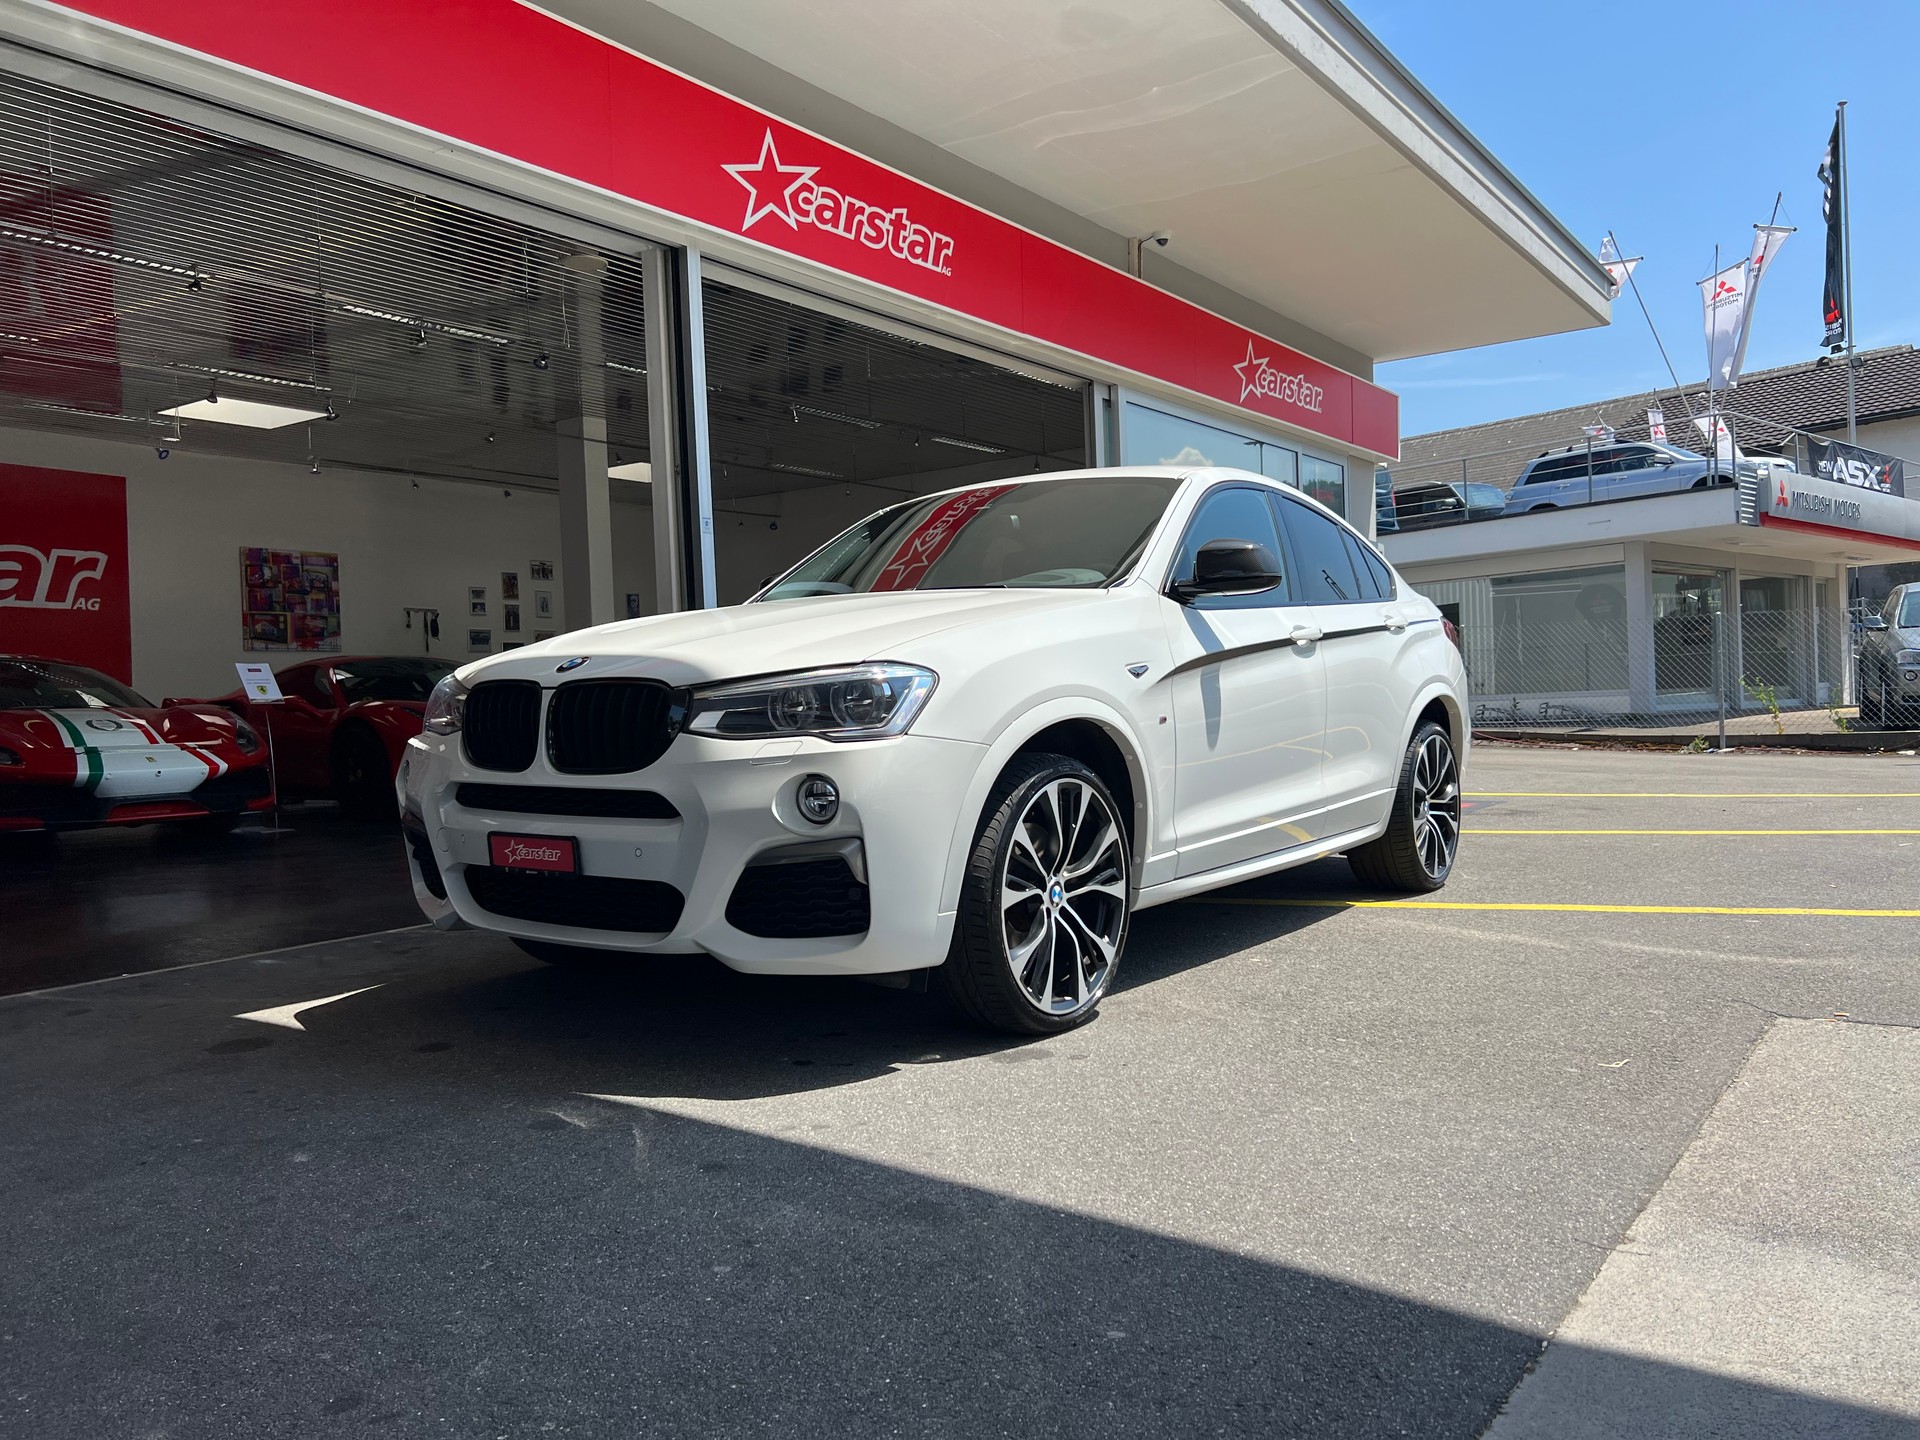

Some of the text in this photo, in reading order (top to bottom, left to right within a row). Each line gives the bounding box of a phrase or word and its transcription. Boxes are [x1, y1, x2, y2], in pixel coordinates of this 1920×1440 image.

[788, 180, 954, 273] carstar
[1256, 367, 1323, 411] carstar
[1833, 456, 1882, 491] ASX
[1792, 490, 1861, 519] MITSUBISHI MOTORS
[73, 598, 101, 611] AG
[517, 846, 561, 861] carstar
